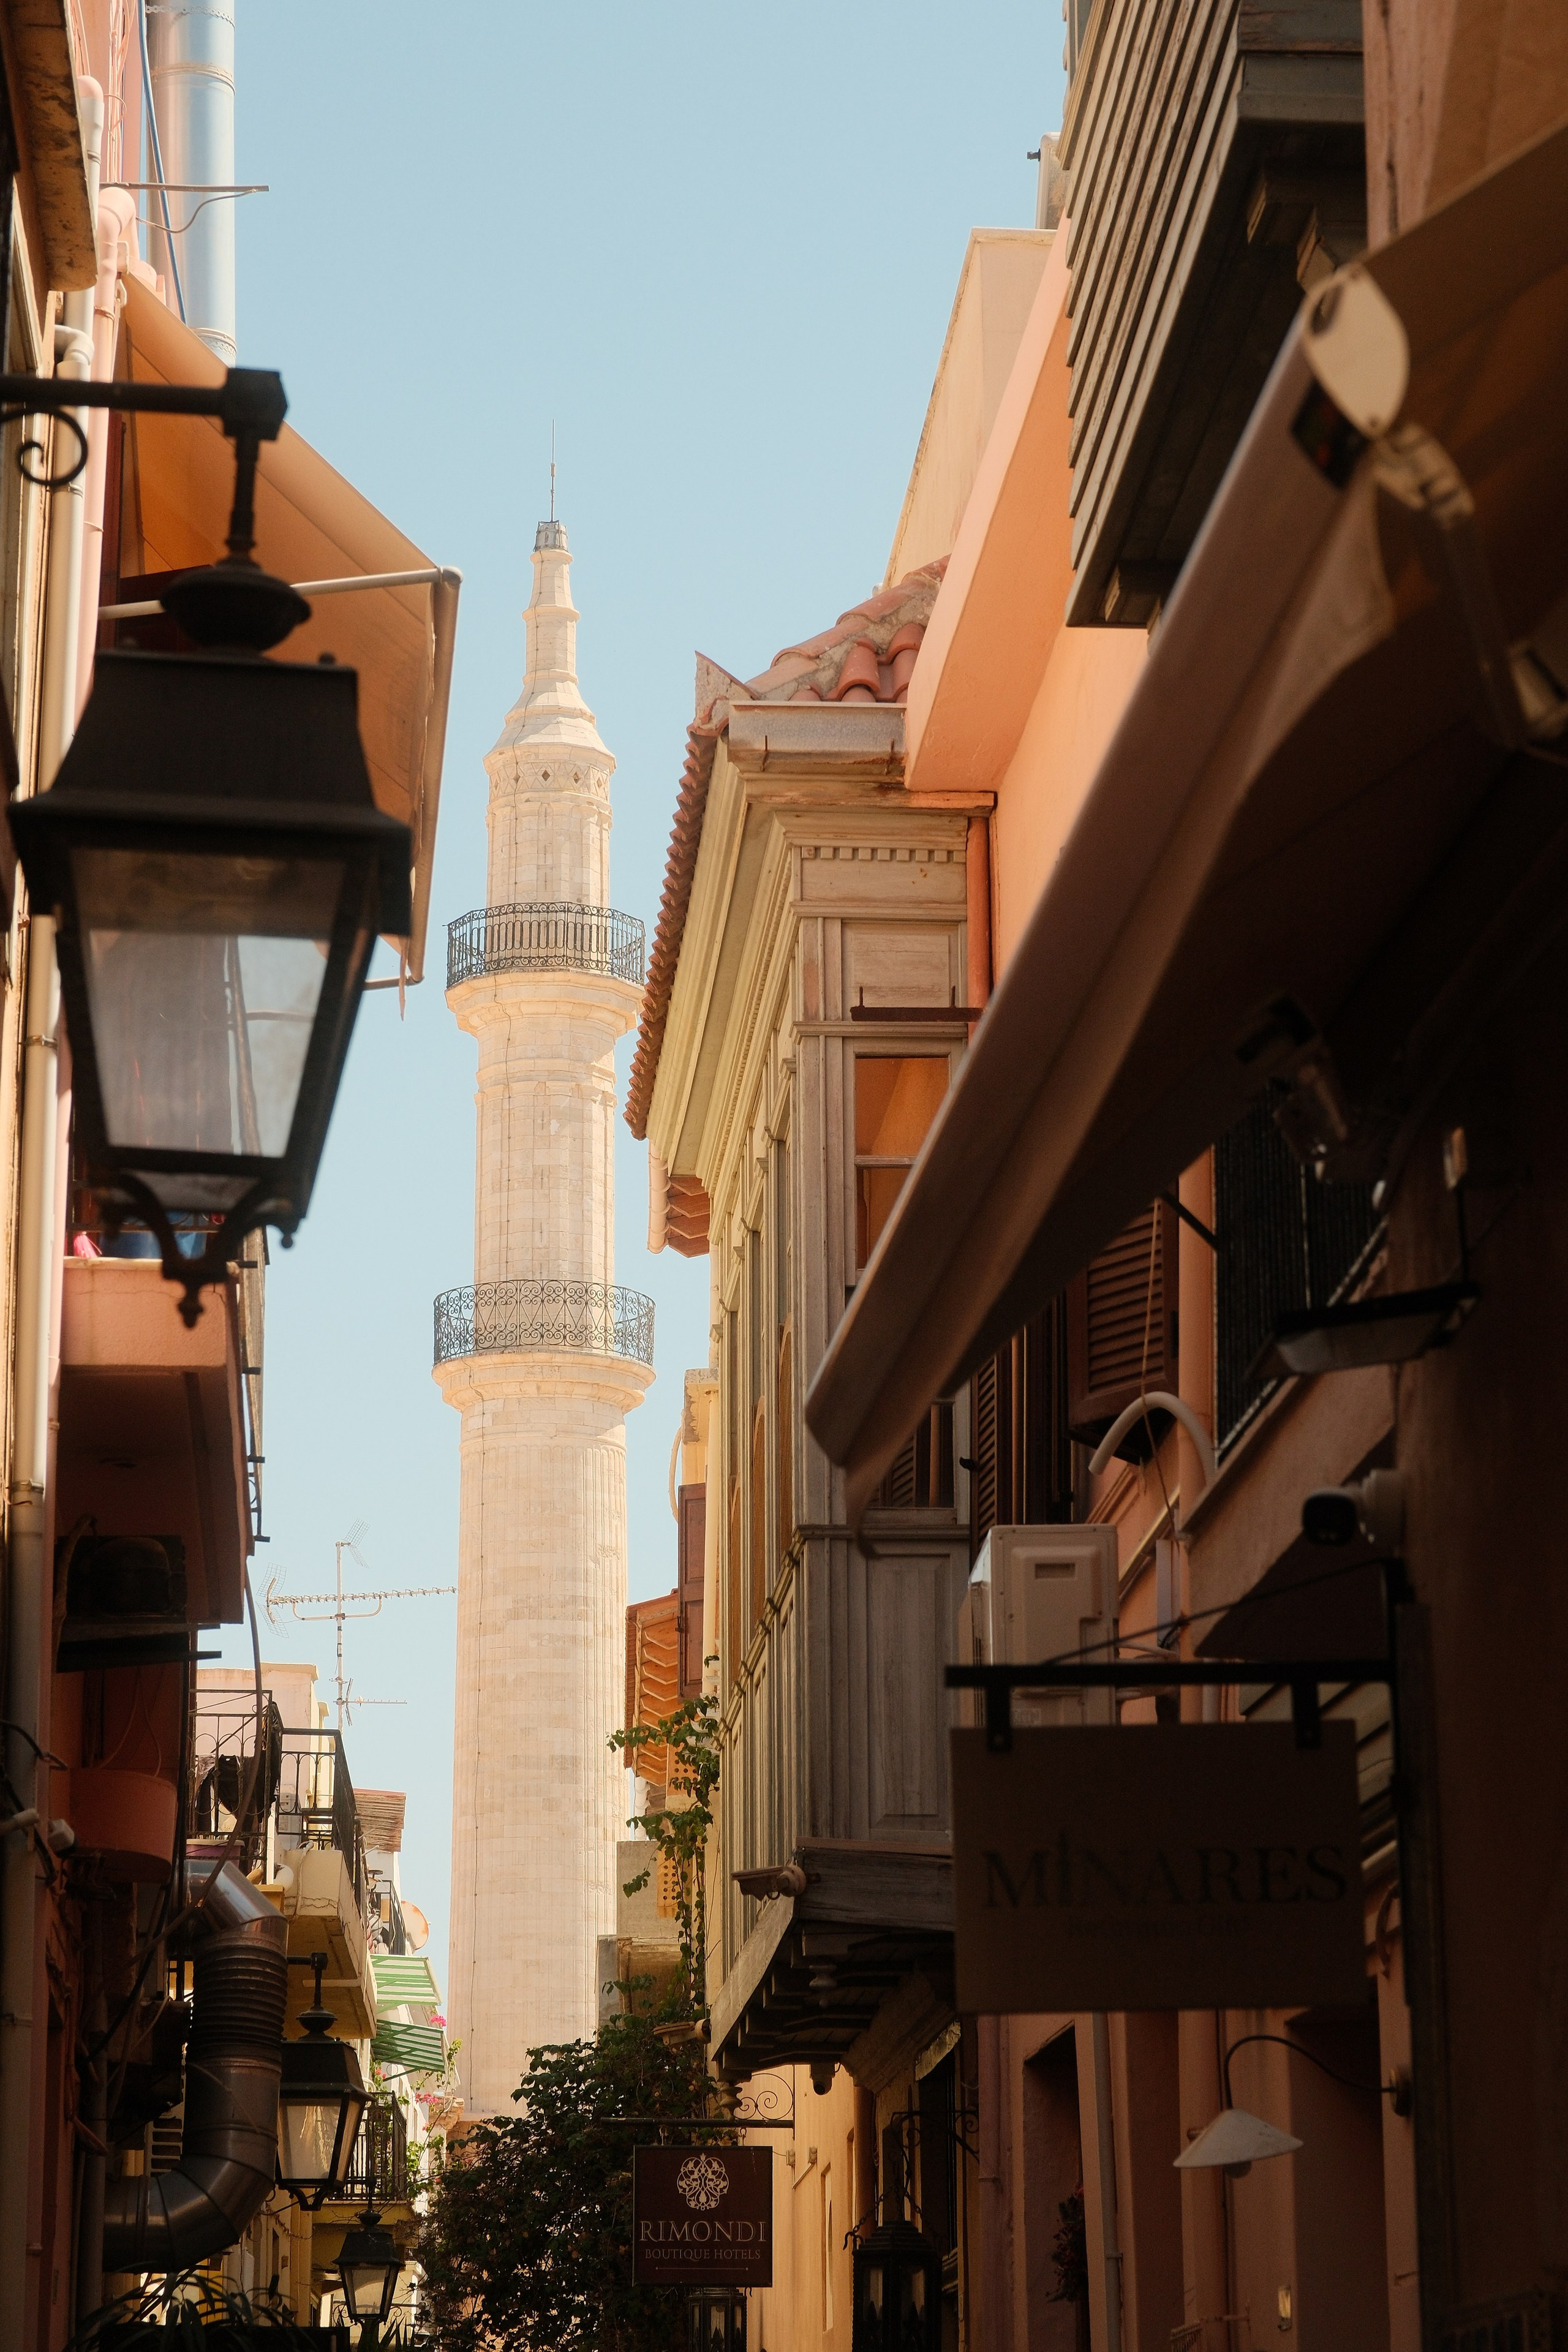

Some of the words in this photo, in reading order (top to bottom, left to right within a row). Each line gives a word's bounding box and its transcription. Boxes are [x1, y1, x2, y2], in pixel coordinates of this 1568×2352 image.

[639, 2220, 767, 2242] RIMONDI
[645, 2248, 710, 2262] BOUTIQUE
[714, 2248, 761, 2260] HOTELS
